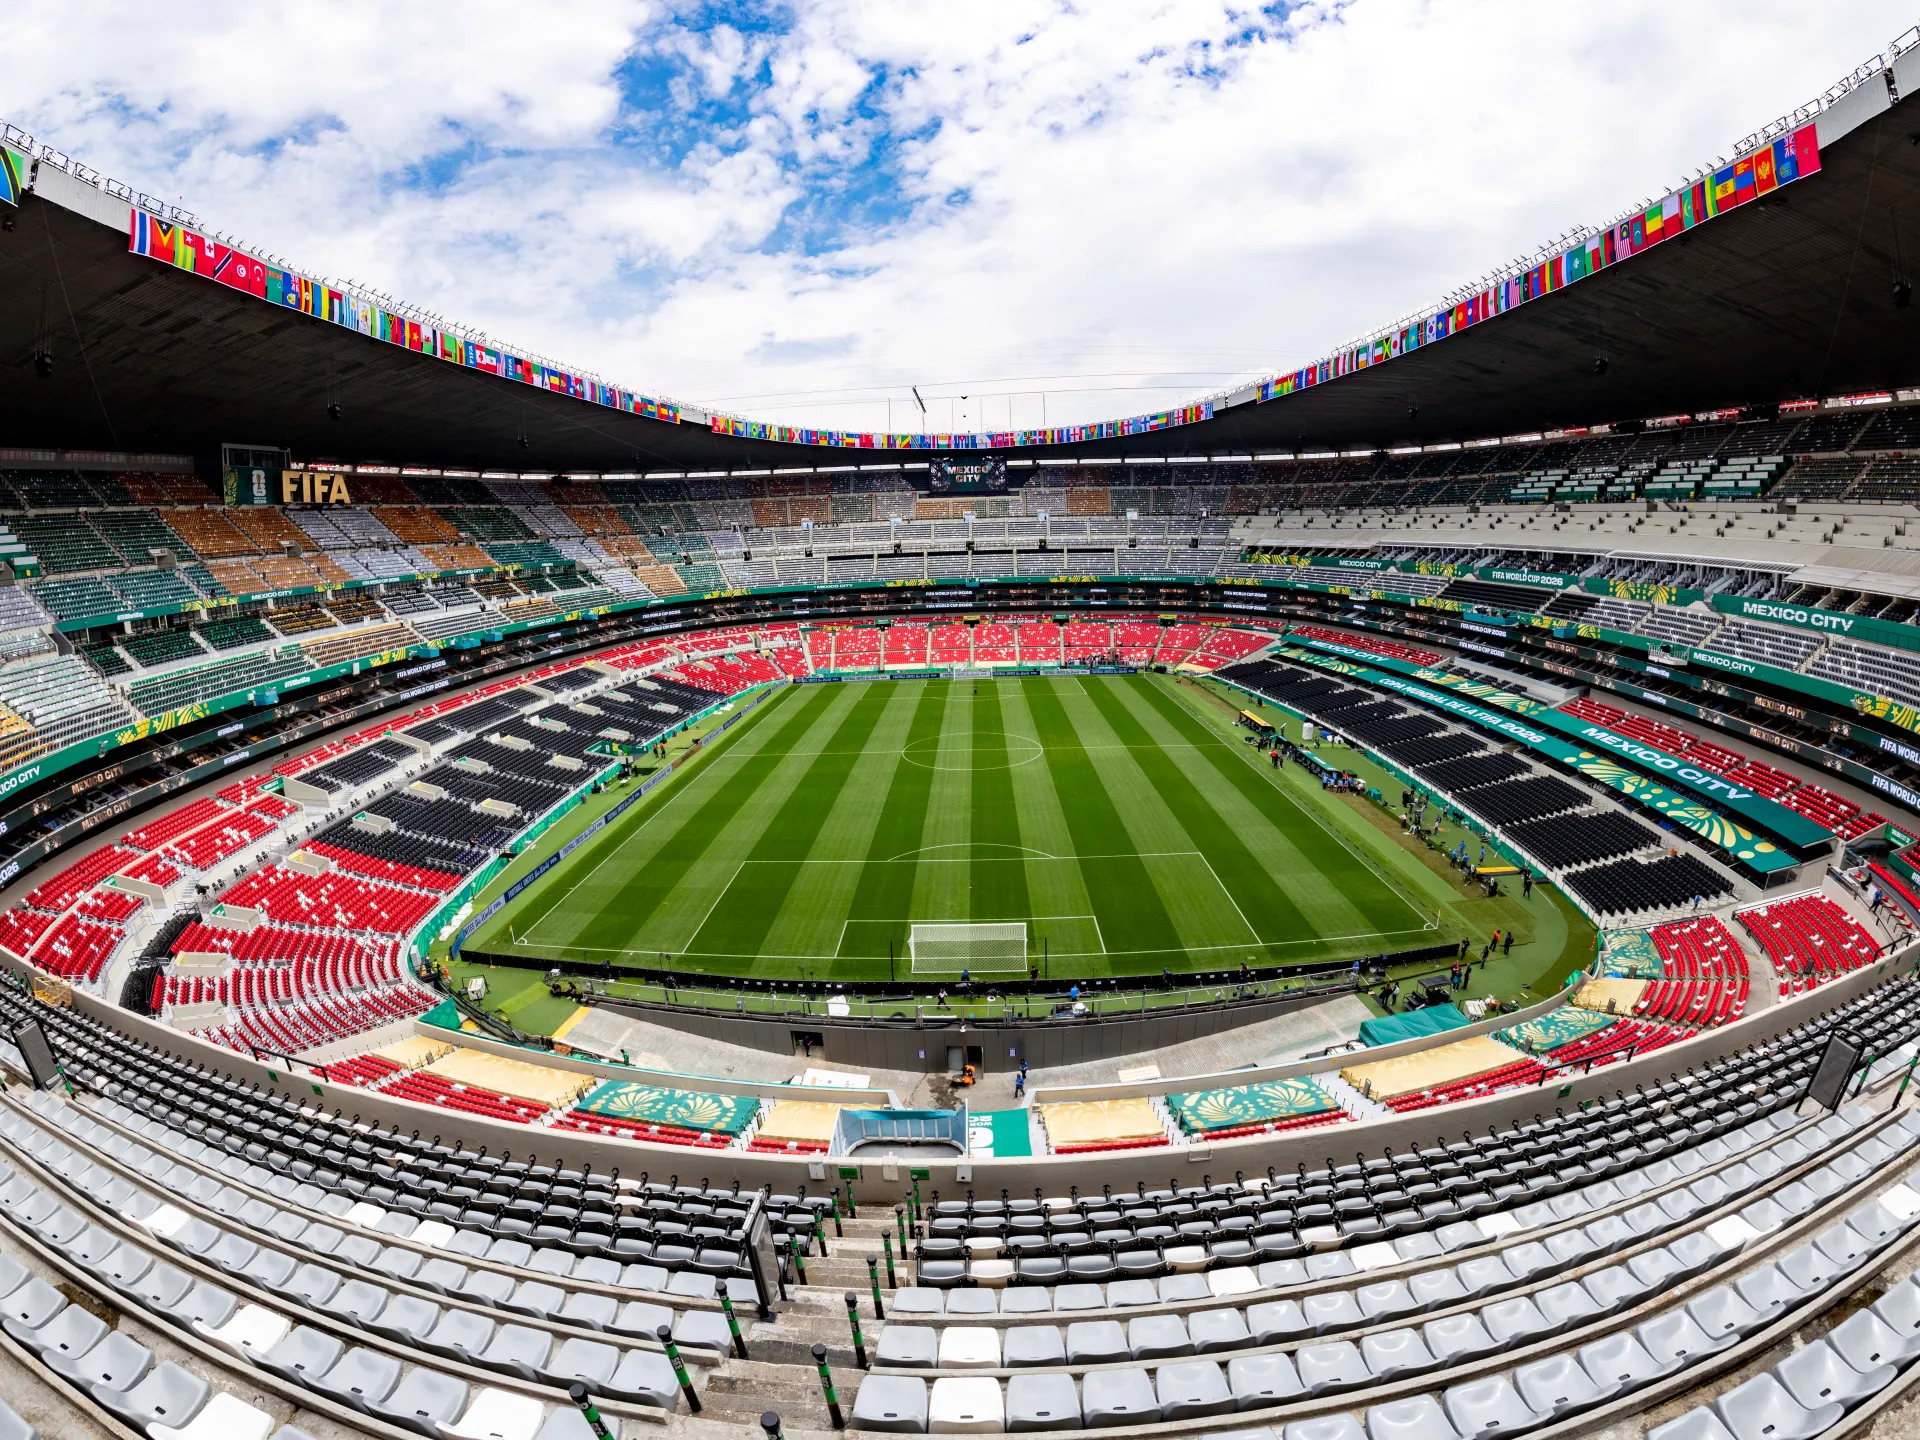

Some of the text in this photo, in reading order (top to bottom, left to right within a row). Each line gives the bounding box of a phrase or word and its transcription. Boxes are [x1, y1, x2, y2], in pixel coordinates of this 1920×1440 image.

[947, 466, 989, 474] MEXICO
[282, 470, 351, 504] FIFA
[1506, 572, 1526, 582] WORLD
[1528, 574, 1540, 583] CUP
[1541, 576, 1563, 586] 2026
[1743, 602, 1854, 631] MEXICO CITY
[1308, 640, 1390, 662] MEXICO CITY
[1566, 645, 1577, 654] CITY
[1564, 668, 1576, 676] CITY
[1693, 652, 1756, 674] MEXICO CITY
[1379, 678, 1406, 690] COPA
[1444, 700, 1462, 710] DE
[1461, 706, 1476, 715] LA
[1473, 711, 1502, 726] FIFA
[1499, 722, 1546, 743] 2026
[1755, 696, 1807, 720] MEXICO CITY
[1749, 728, 1801, 752] MEXICO CITY
[1880, 738, 1920, 764] FIFA WORL
[1581, 728, 1753, 800] MEXICO CITY
[0, 766, 40, 795] ICO CITY
[71, 766, 124, 794] MEXICO CITY
[1872, 775, 1889, 792] FIFA
[1890, 783, 1916, 804] WORLD
[82, 800, 132, 830] MEXICO CITY
[0, 862, 19, 884] 026
